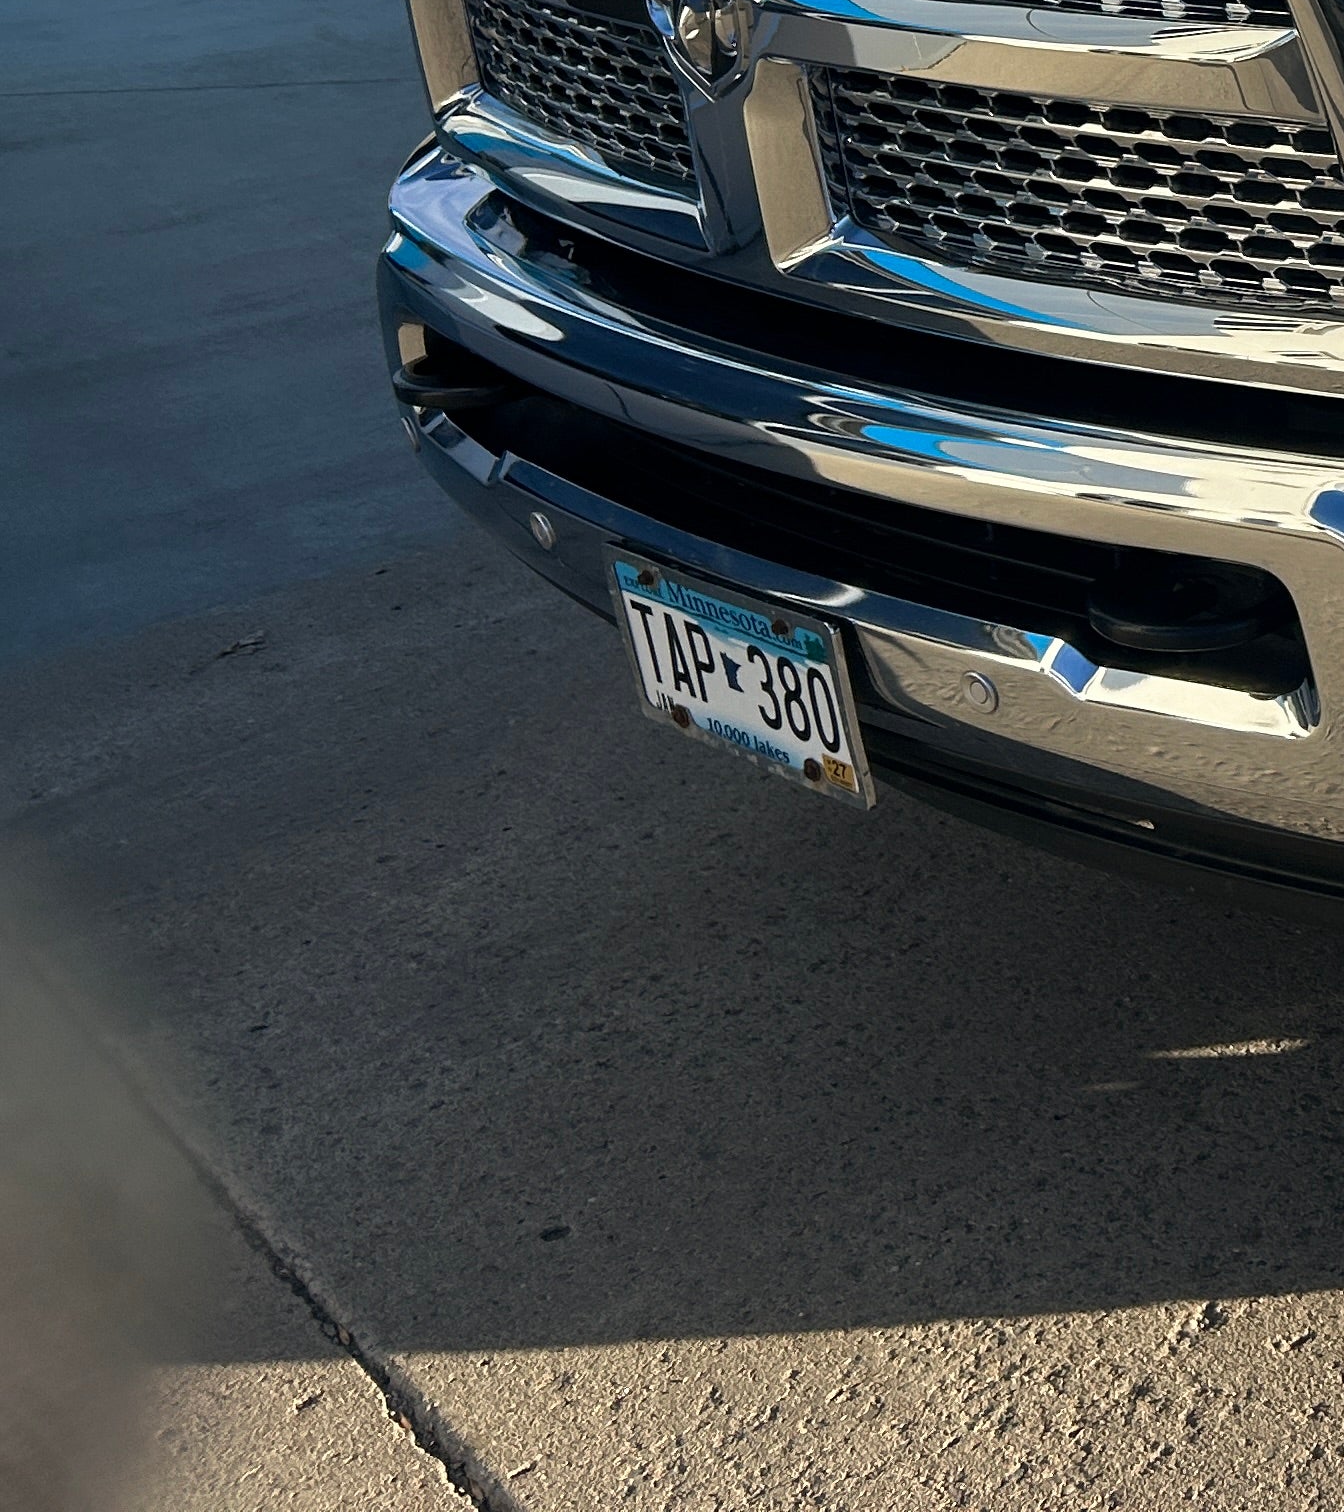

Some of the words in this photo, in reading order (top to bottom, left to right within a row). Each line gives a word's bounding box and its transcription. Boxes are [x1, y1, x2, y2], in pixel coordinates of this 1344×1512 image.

[630, 599, 716, 703] TAP
[746, 644, 841, 754] 380
[753, 735, 791, 764] lakes
[831, 759, 847, 779] 27
